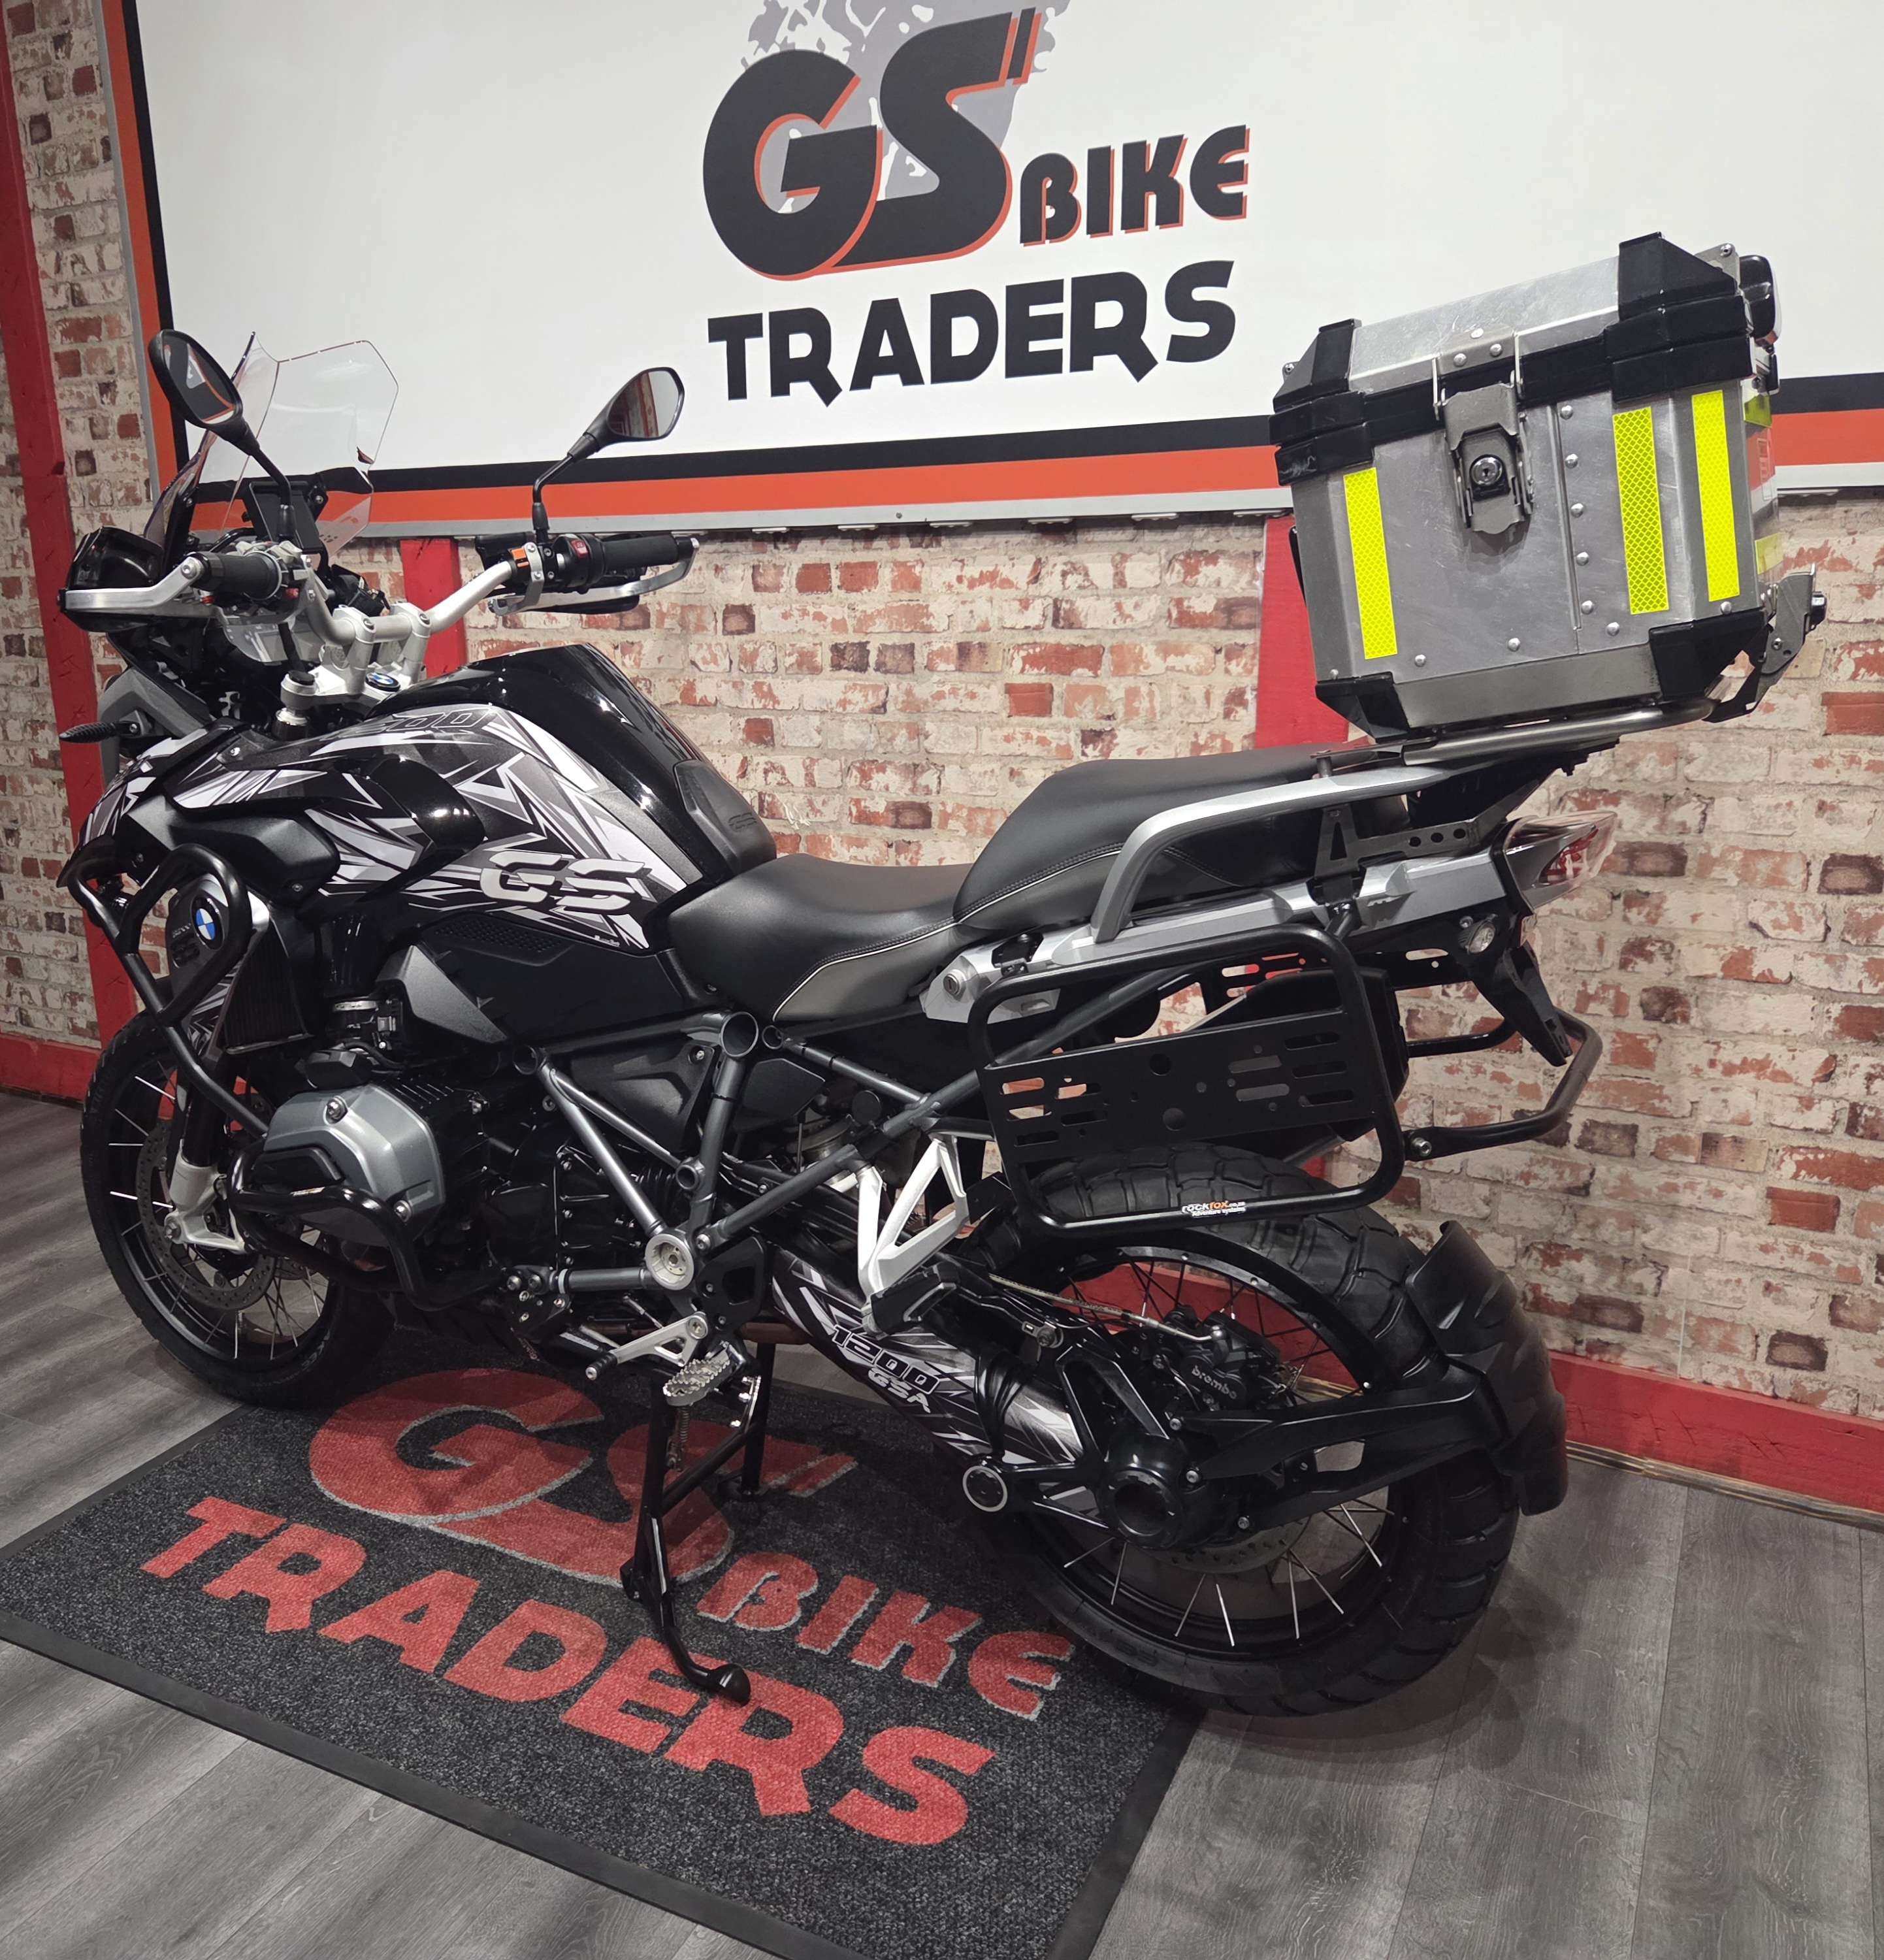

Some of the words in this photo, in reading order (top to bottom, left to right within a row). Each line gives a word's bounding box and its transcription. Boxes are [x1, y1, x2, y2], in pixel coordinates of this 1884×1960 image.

[703, 8, 1042, 281] GS
[1020, 124, 1250, 247] BIKE
[707, 260, 1236, 408] TRADERS
[479, 850, 645, 910] GS
[831, 1324, 940, 1395] 1200
[868, 1368, 932, 1413] GSA
[1191, 1365, 1237, 1399] brembo
[138, 1497, 994, 1846] TRADERS
[696, 1552, 1075, 1721] BIKE
